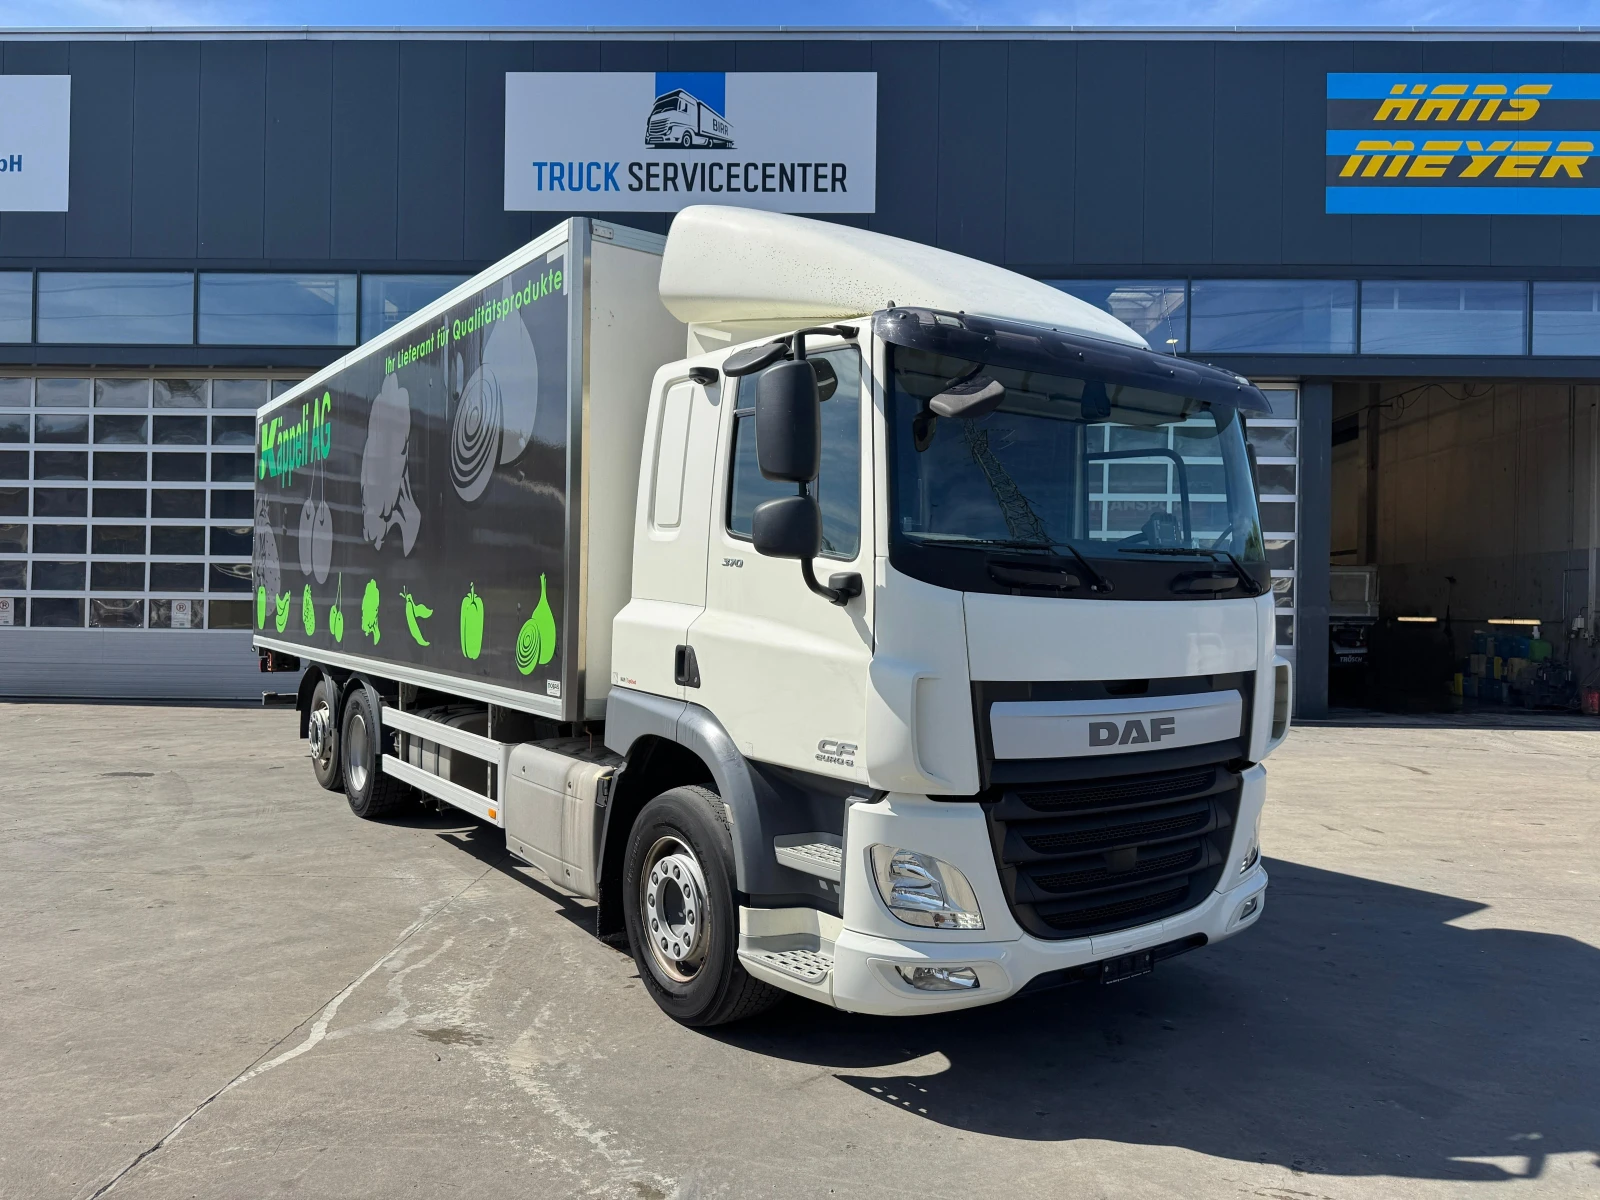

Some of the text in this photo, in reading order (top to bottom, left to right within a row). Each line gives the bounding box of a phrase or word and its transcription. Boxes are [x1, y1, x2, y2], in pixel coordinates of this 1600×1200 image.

[1373, 84, 1553, 121] HANS
[713, 118, 729, 136] BIRR
[1339, 140, 1595, 178] MEYER
[532, 161, 848, 193] TRUCK SERVICECENTER
[385, 268, 563, 375] Ihr Lieferant für Qualitätsprodukte
[310, 391, 332, 464] AG
[722, 557, 744, 568] 370
[818, 740, 858, 756] CF
[1088, 716, 1176, 748] DAF
